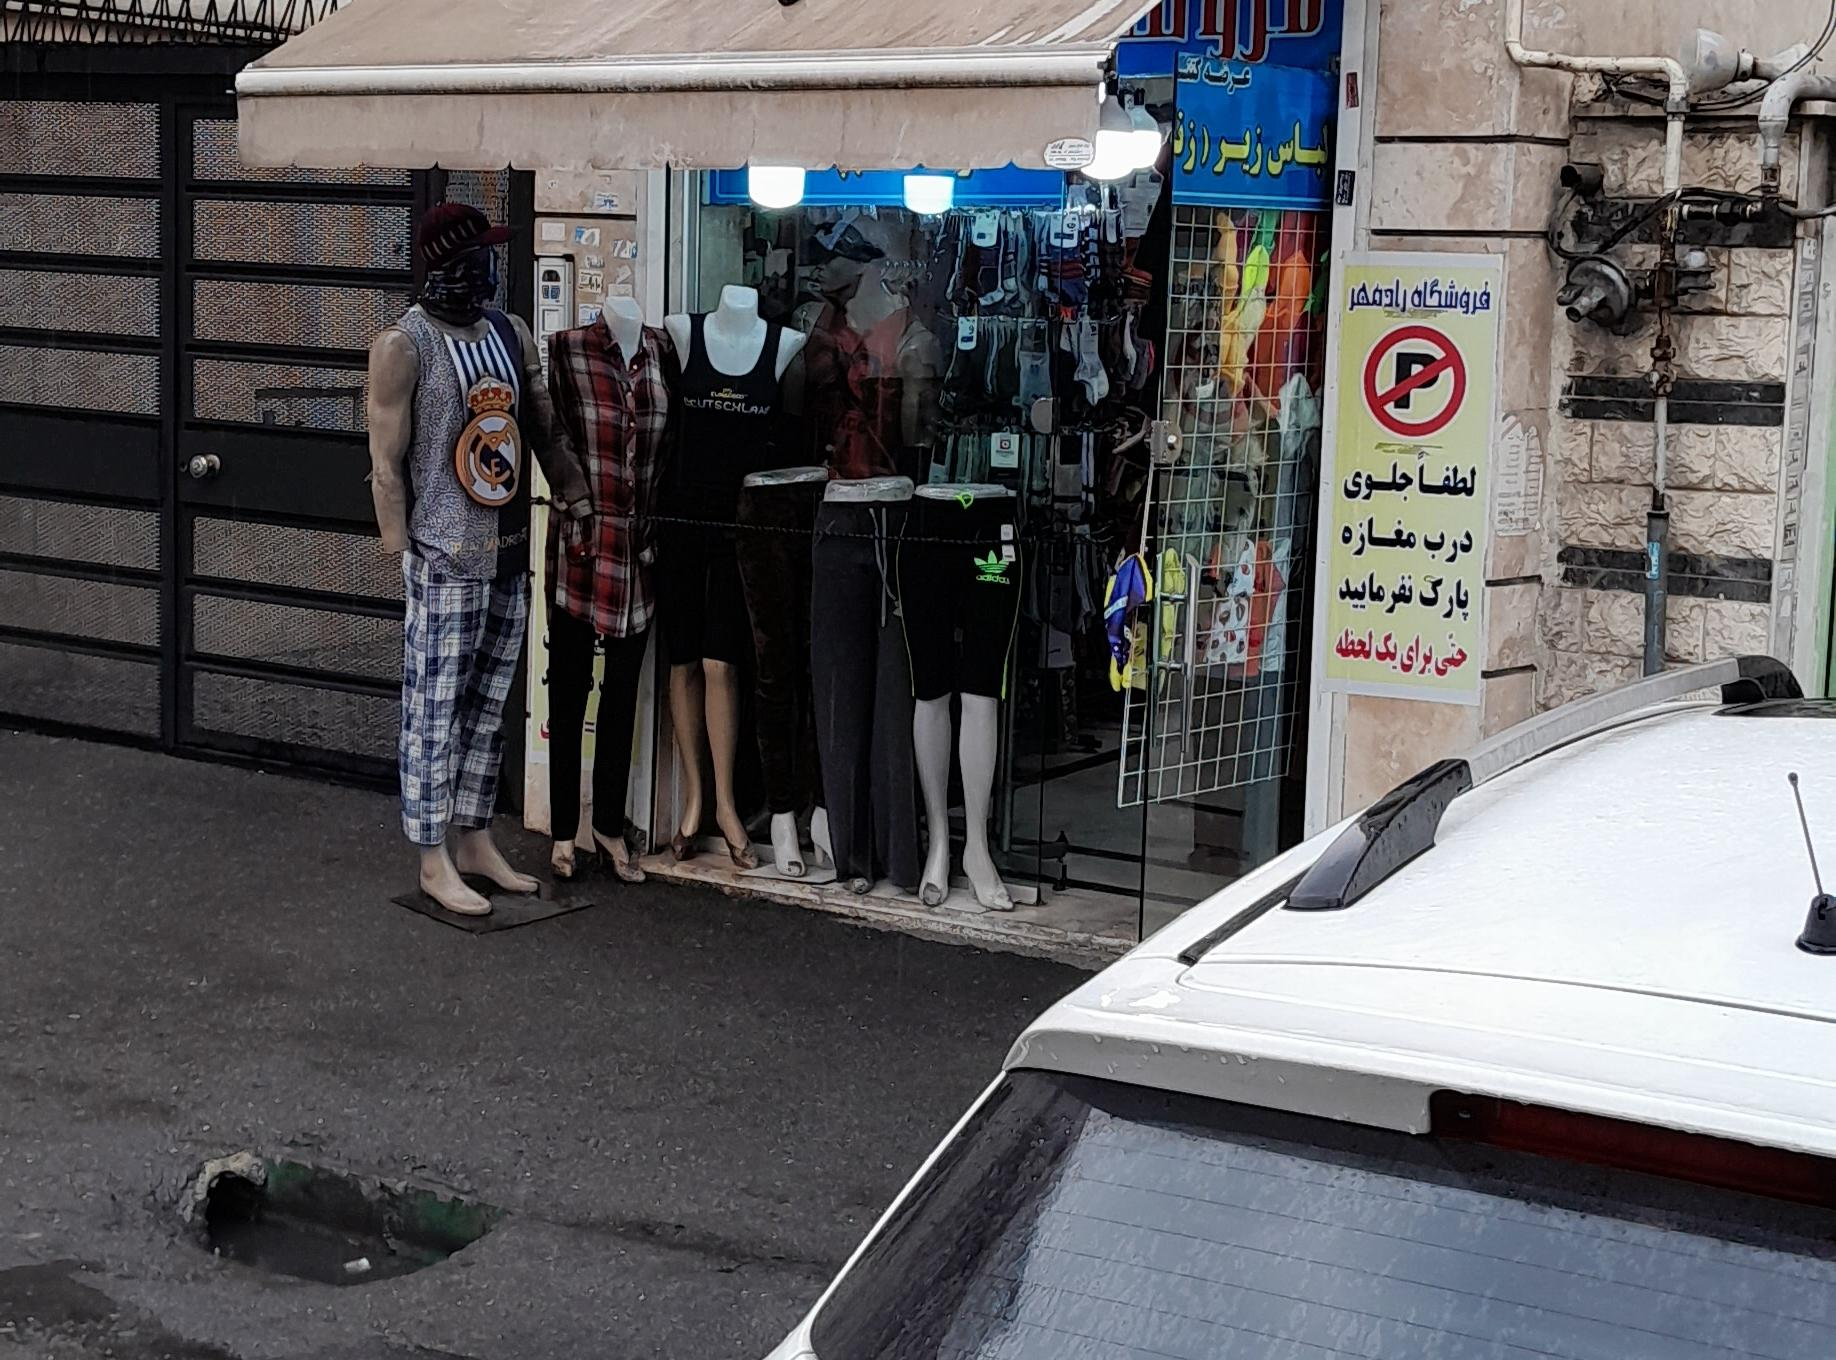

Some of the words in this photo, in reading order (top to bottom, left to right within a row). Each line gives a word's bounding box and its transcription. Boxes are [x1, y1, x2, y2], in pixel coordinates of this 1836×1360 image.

[1213, 127, 1262, 175] زیر
[1266, 120, 1329, 176] لباس
[1349, 279, 1406, 312] رادمهر
[1411, 279, 1490, 314] فروشگاه
[1344, 461, 1413, 501] جلوی
[1342, 517, 1416, 556] مغازه
[1424, 530, 1473, 562] درب
[1339, 571, 1413, 613] نفرمایید
[1419, 577, 1468, 621] پارک
[1336, 628, 1373, 659] لحظه
[1376, 632, 1397, 669] یک
[1401, 635, 1432, 674] برای
